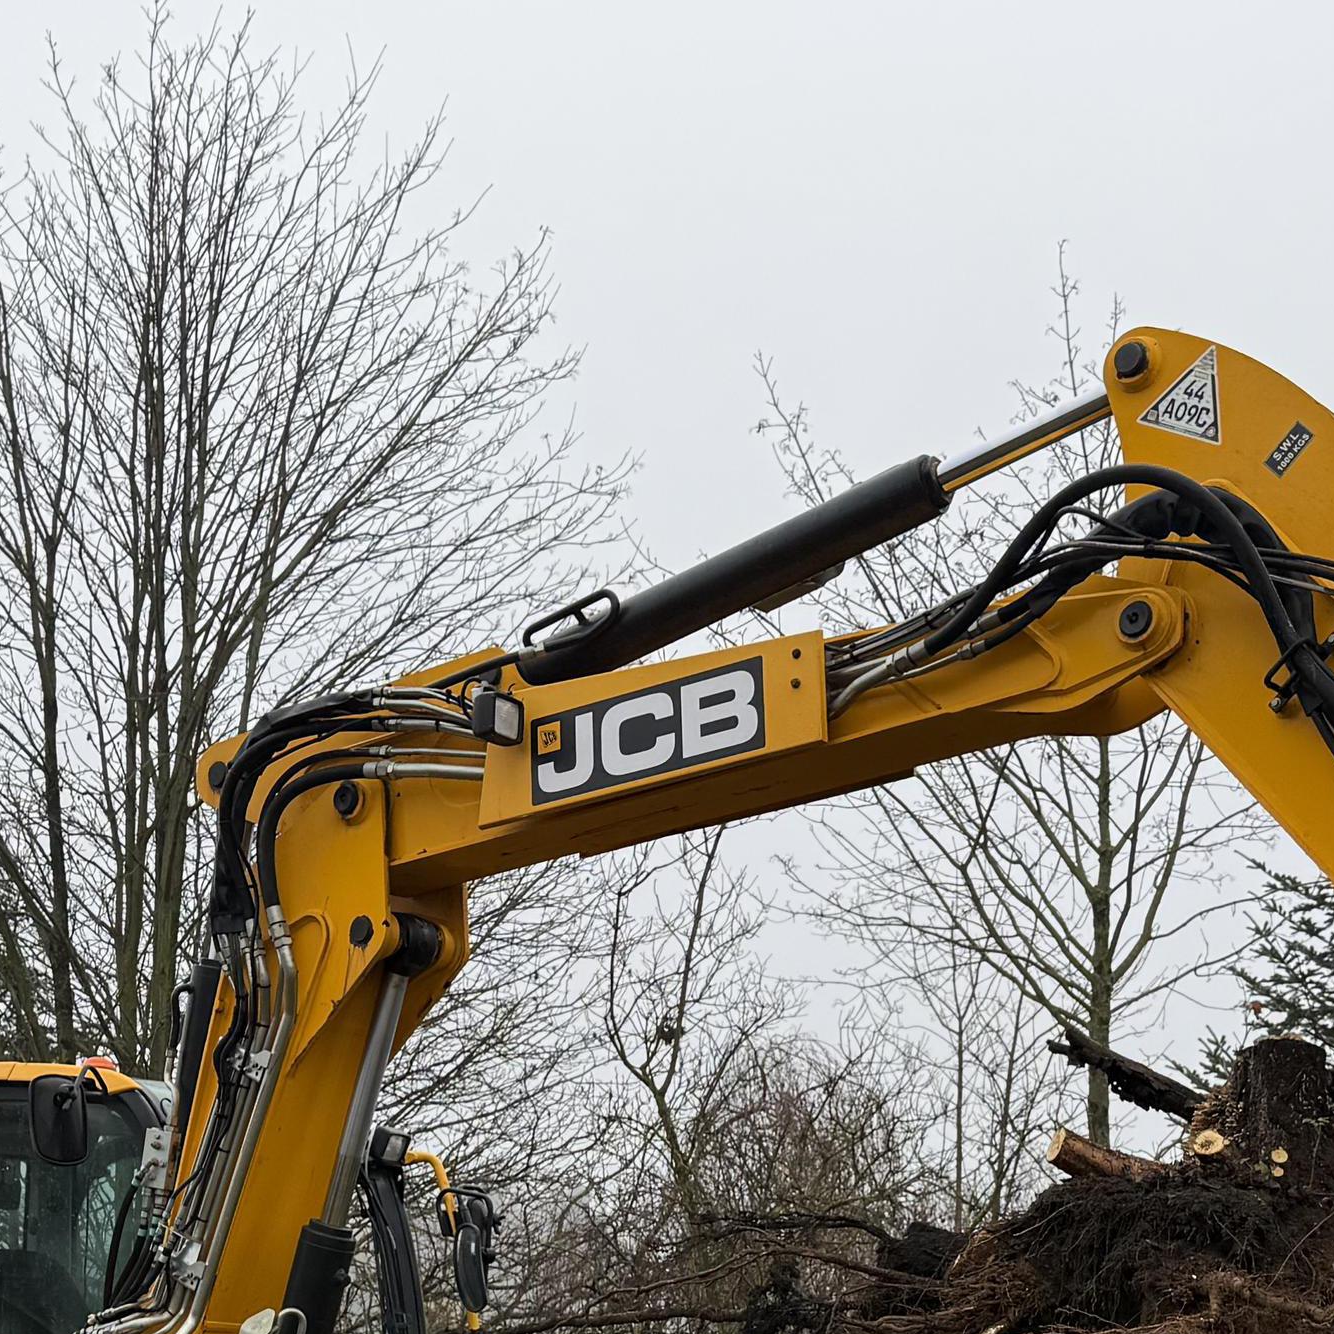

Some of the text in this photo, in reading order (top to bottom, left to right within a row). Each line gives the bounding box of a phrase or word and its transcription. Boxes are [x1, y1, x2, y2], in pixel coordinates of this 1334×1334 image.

[1183, 380, 1208, 403] 44
[1277, 434, 1310, 471] 1000 KGS
[537, 670, 759, 793] JCB
